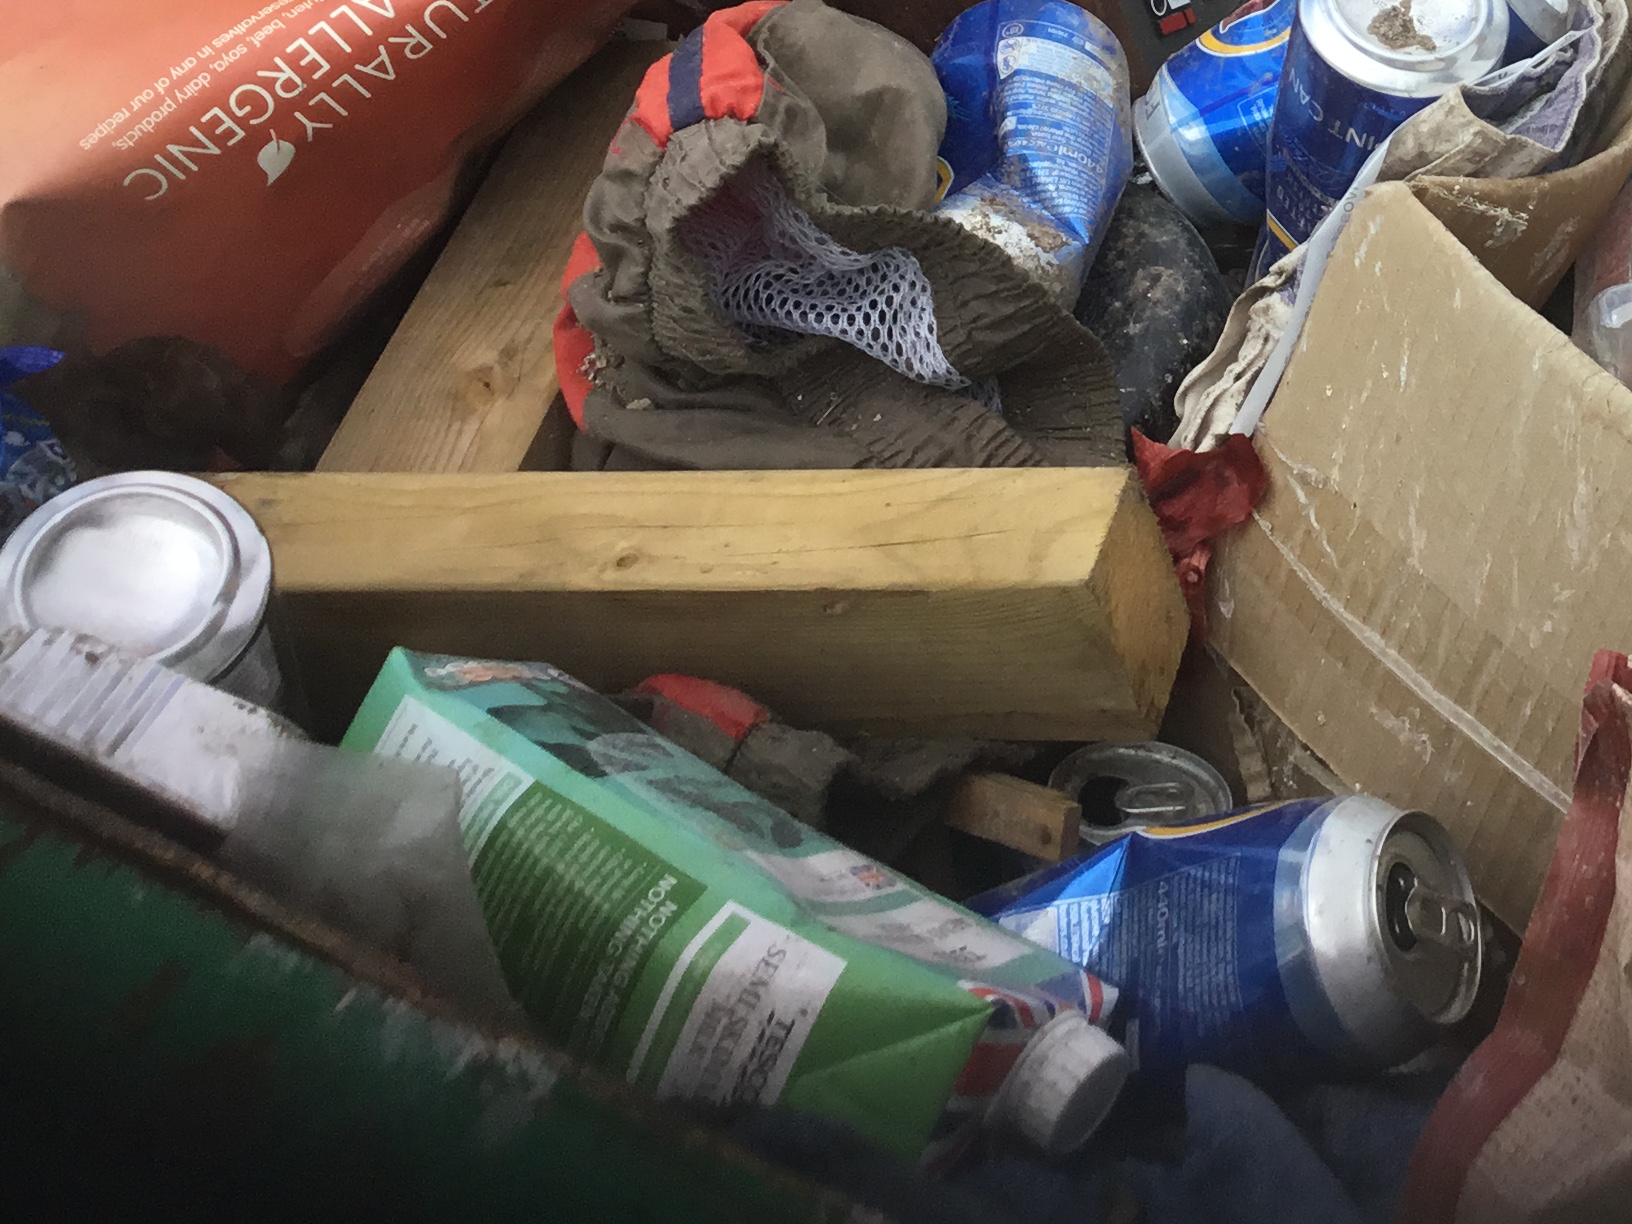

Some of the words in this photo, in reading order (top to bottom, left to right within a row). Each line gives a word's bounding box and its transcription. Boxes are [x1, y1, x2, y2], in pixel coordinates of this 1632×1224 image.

[246, 18, 287, 48] beef,
[199, 44, 216, 60] in
[208, 43, 248, 73] soya,
[169, 57, 197, 80] any
[130, 89, 155, 113] our
[153, 77, 170, 95] of
[177, 71, 211, 105] dairy
[1288, 67, 1325, 122] CAN
[79, 107, 130, 150] recipes
[111, 98, 178, 151] products,
[1326, 119, 1381, 151] INT
[1055, 146, 1104, 175] 440ml
